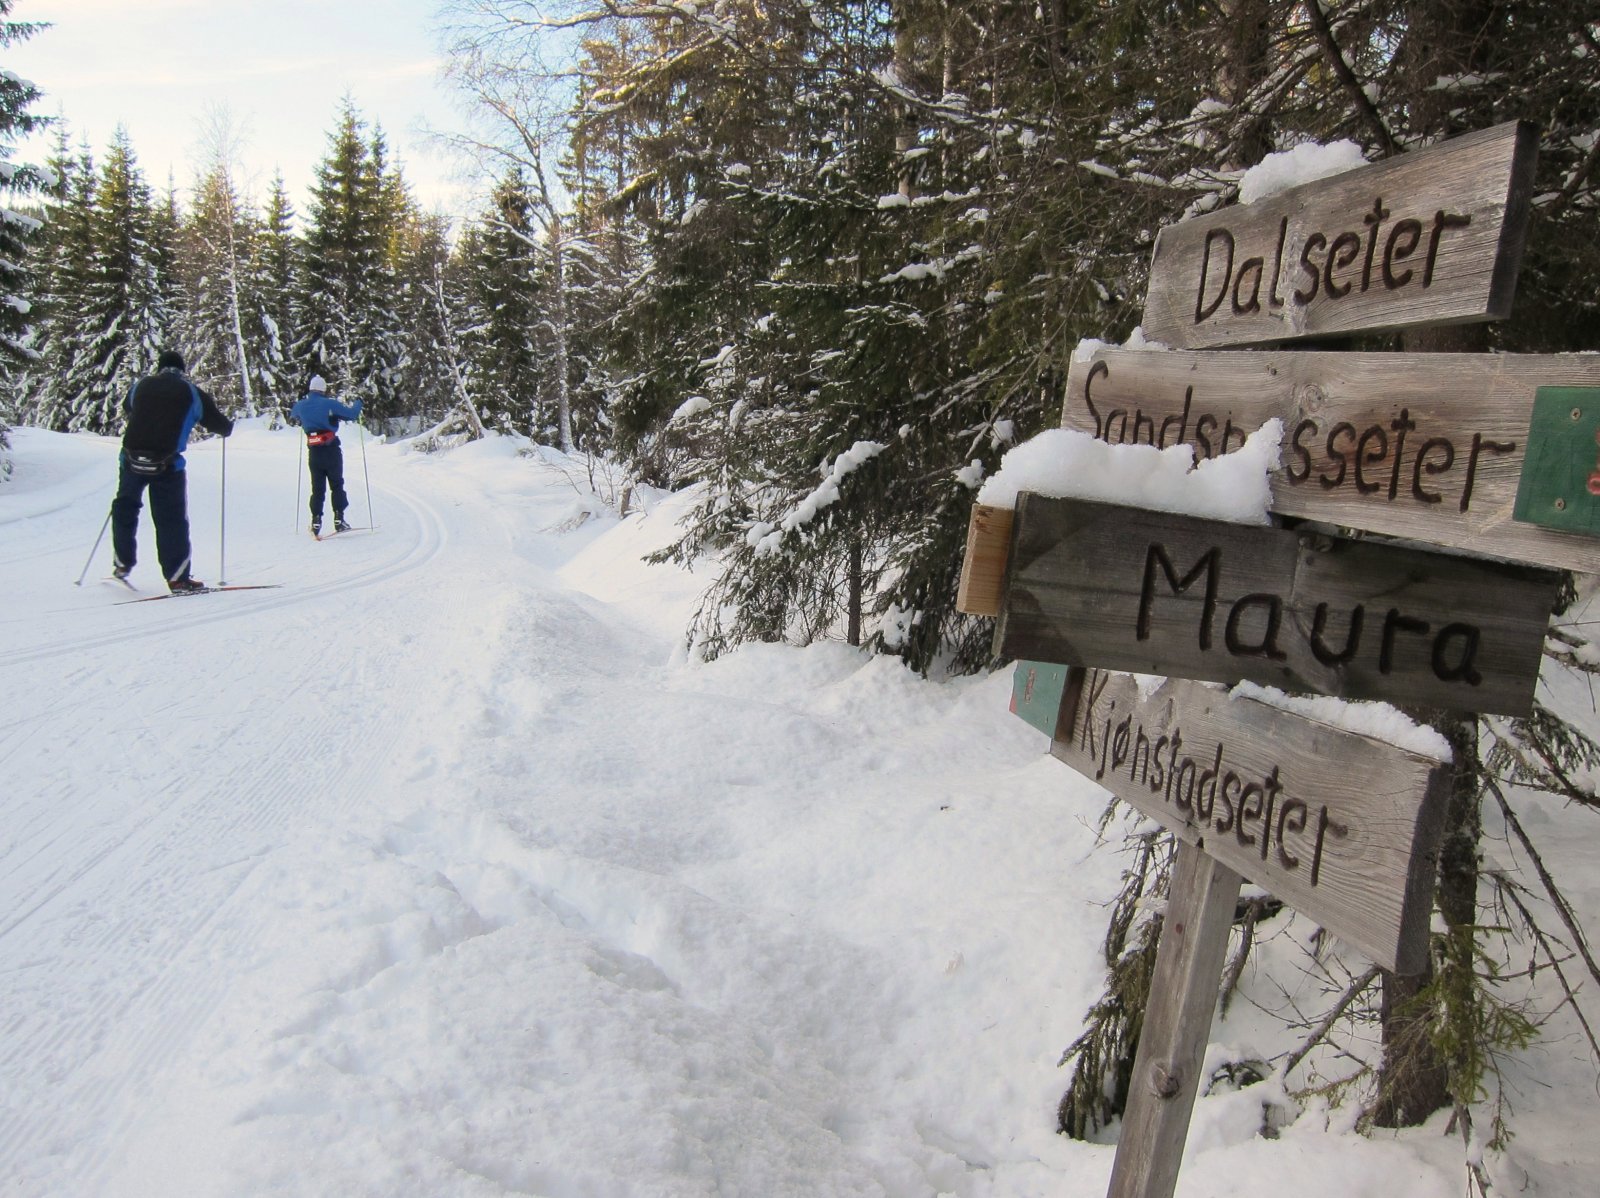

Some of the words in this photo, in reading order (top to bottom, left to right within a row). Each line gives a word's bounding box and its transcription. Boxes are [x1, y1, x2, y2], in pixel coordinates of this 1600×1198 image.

[1195, 198, 1471, 324] Dalseter
[1085, 360, 1516, 512] Sandsnsseter
[1137, 543, 1482, 686] Maura
[1081, 669, 1348, 886] Kjønstadseter
